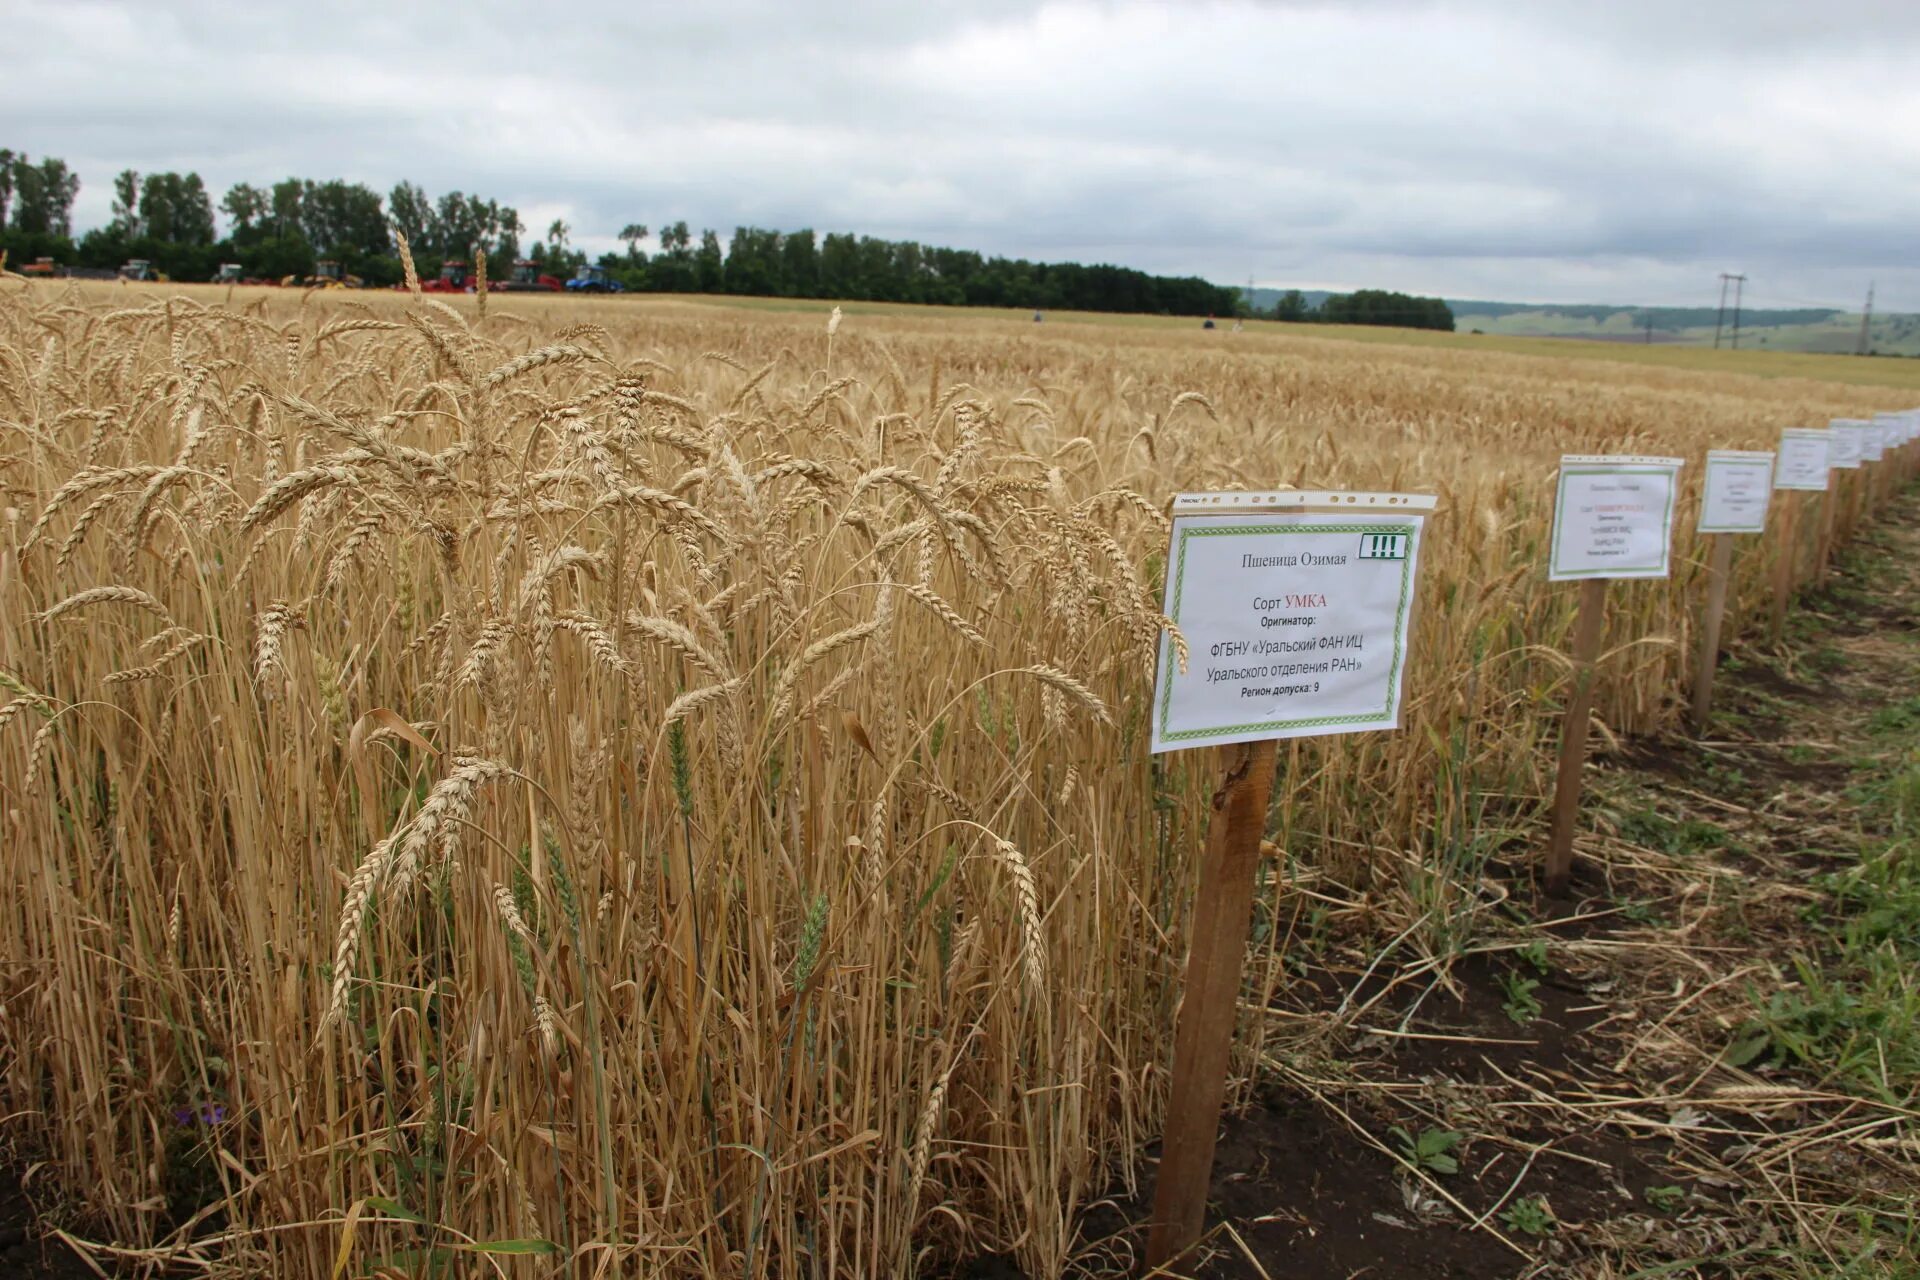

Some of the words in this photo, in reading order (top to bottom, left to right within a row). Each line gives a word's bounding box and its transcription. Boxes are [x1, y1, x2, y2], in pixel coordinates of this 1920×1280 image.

[1242, 553, 1297, 569] Пшеница
[1302, 551, 1347, 566] Озимая
[1253, 597, 1281, 611] Сорт
[1285, 594, 1327, 608] УМКА
[1260, 616, 1316, 628] Оригинатор:
[1210, 641, 1250, 657] ФГБНУ
[1253, 637, 1316, 656] «Уральский
[1317, 636, 1344, 649] ФАН
[1346, 634, 1363, 650] ИЦ
[1207, 665, 1269, 683] Уральского
[1270, 661, 1328, 677] отделения
[1331, 657, 1362, 671] РАН»
[1241, 686, 1271, 698] Регион
[1273, 683, 1312, 697] допуска:
[1314, 681, 1320, 692] 9
